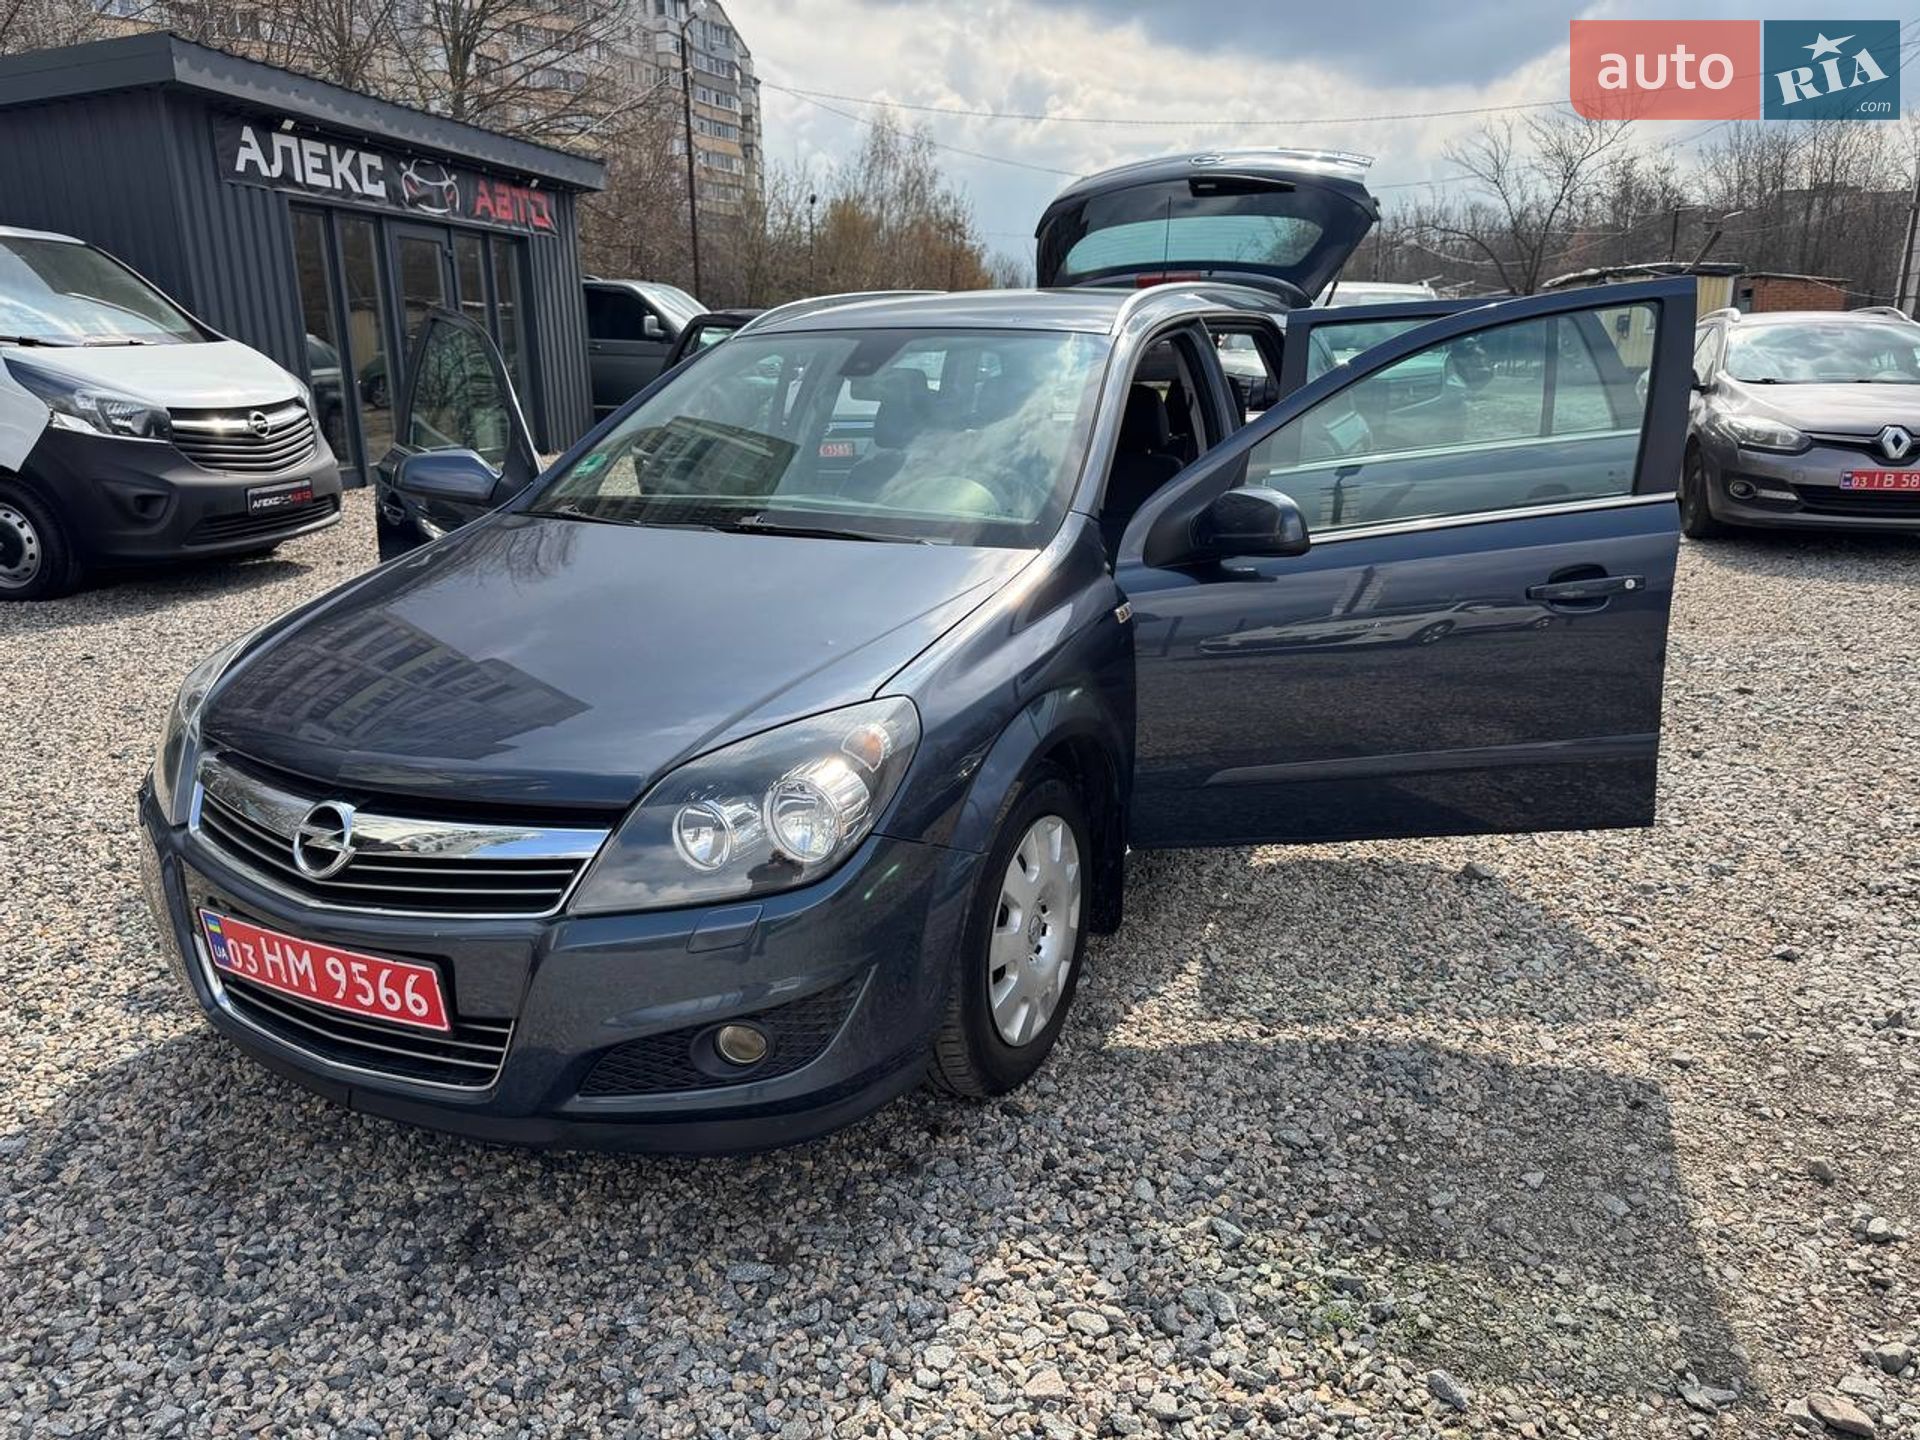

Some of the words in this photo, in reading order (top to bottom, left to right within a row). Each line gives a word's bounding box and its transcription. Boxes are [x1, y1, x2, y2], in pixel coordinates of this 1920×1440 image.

[235, 125, 387, 198] АЛЕКС
[473, 179, 552, 229] АВТО
[214, 945, 229, 961] UA
[226, 937, 259, 975] 03
[324, 956, 429, 1017] 9566
